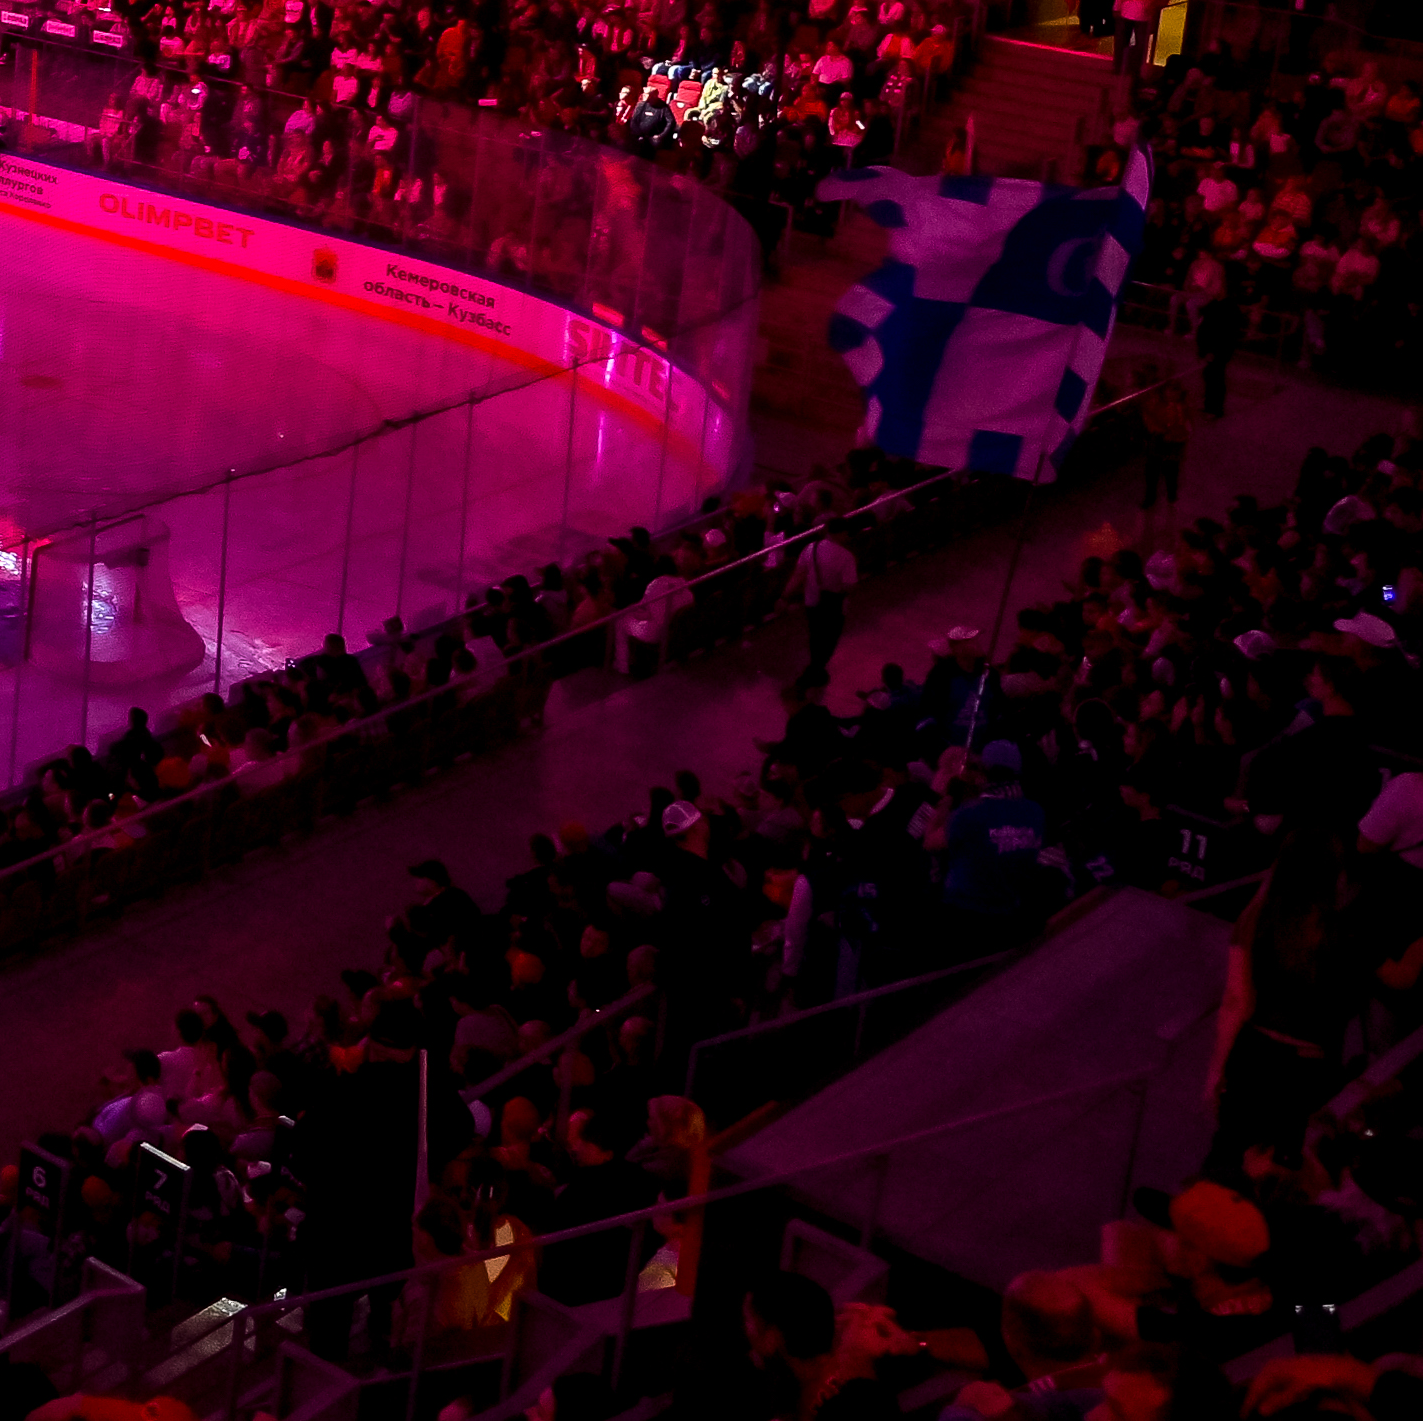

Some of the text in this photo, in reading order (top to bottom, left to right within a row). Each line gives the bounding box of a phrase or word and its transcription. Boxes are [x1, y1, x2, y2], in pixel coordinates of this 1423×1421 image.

[98, 192, 255, 250] OLIMPBET
[385, 262, 496, 311] Кемеровская
[1178, 828, 1208, 861] 11
[31, 1165, 47, 1189] 6
[153, 1167, 168, 1190] 7
